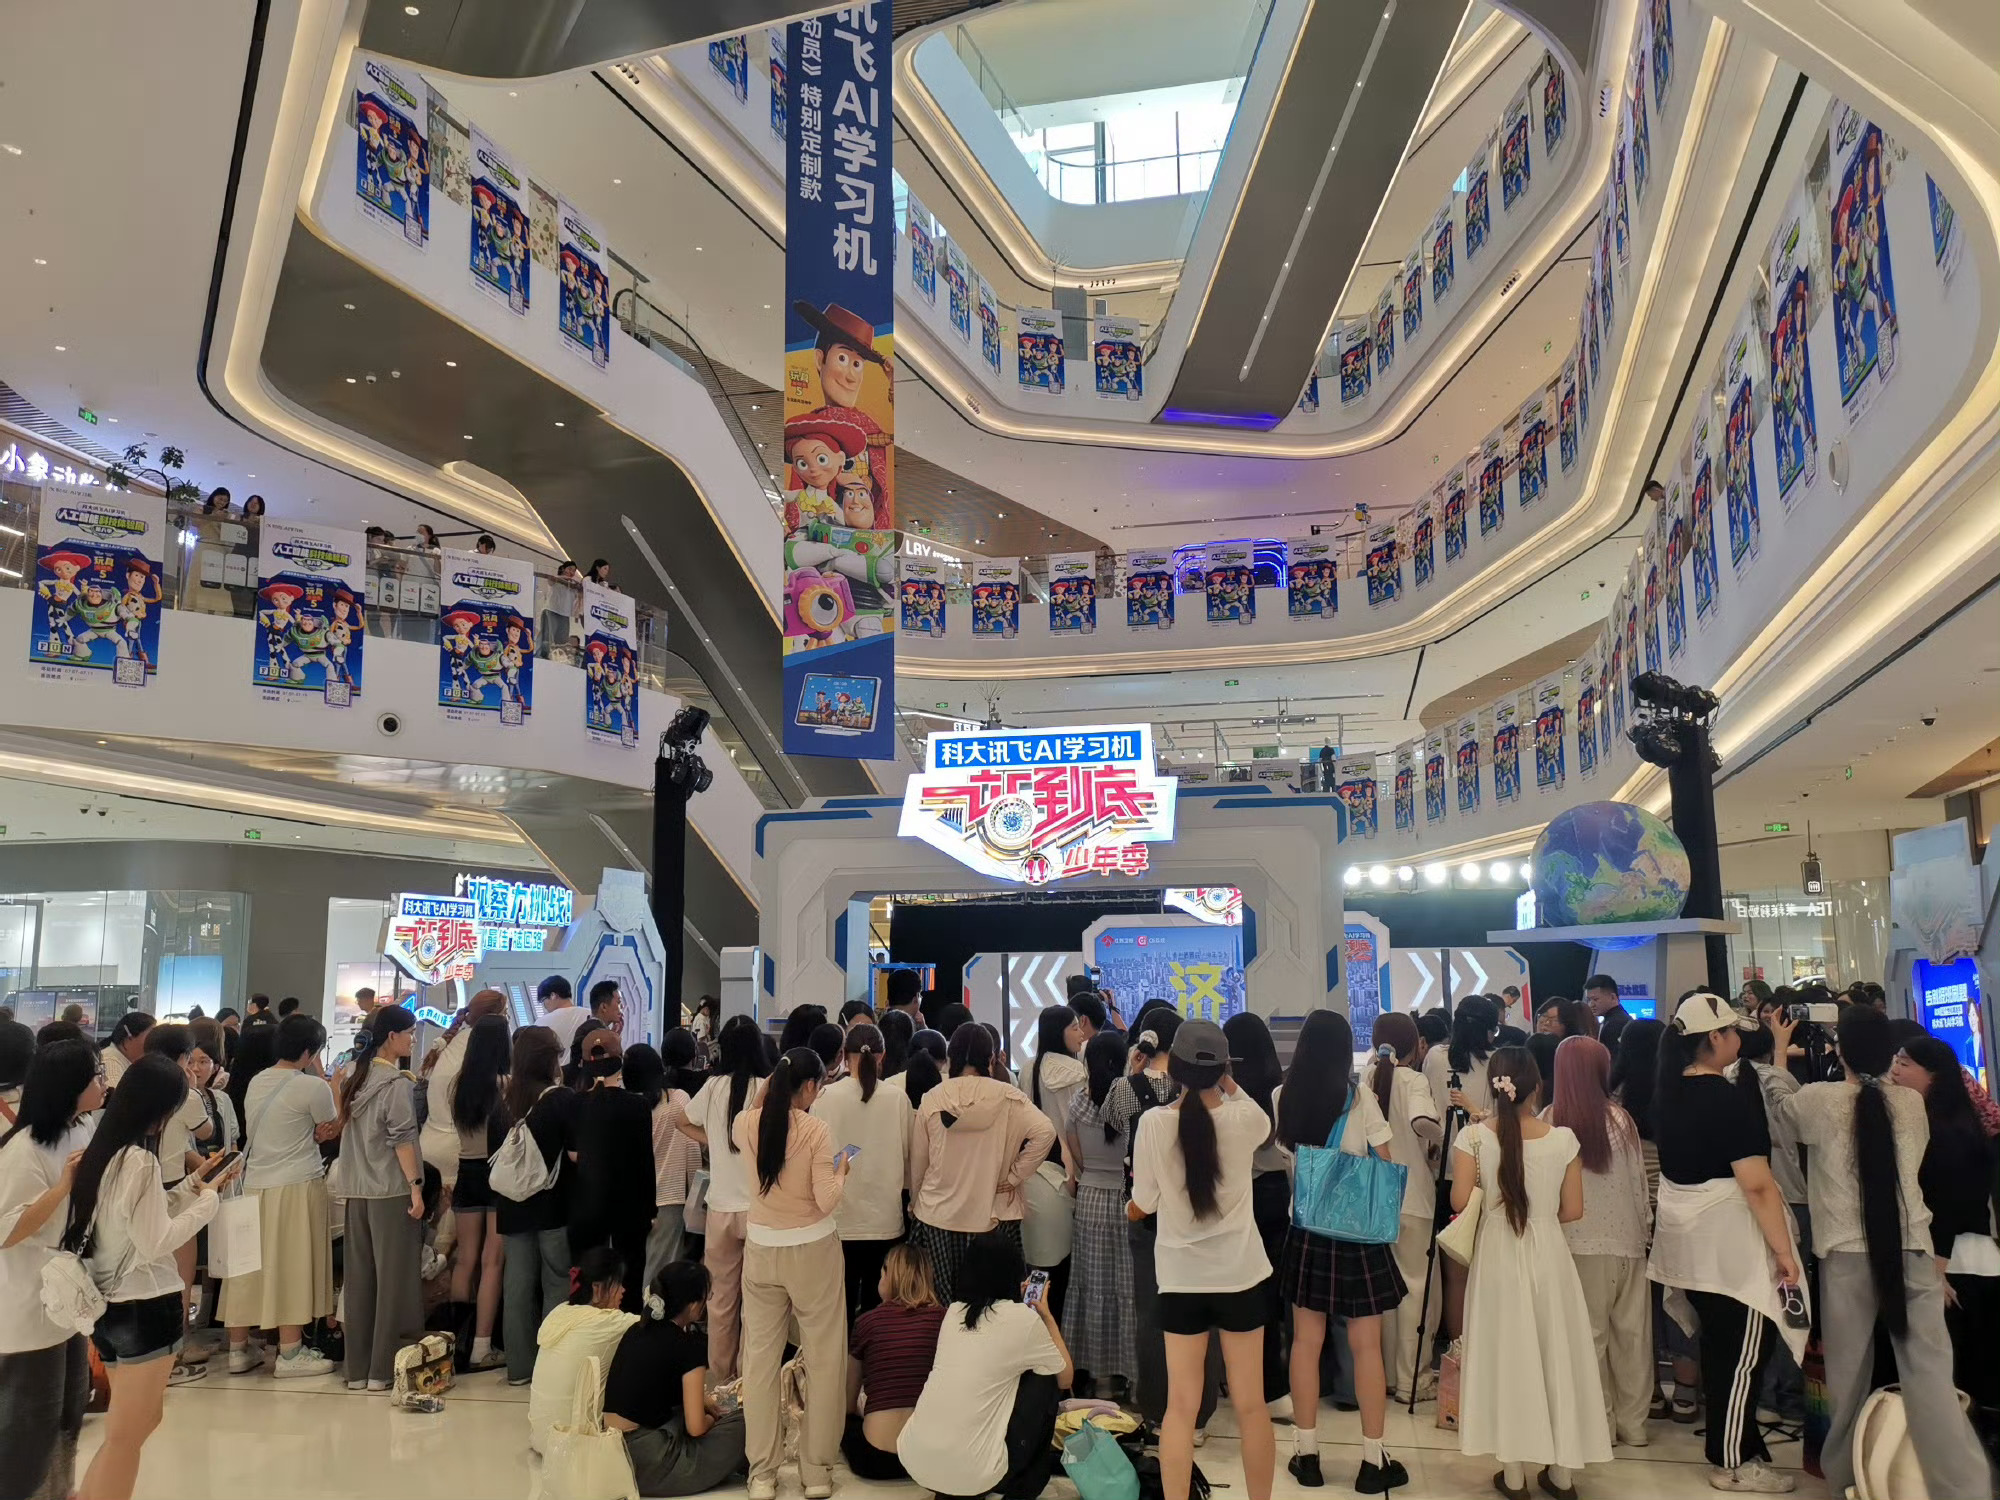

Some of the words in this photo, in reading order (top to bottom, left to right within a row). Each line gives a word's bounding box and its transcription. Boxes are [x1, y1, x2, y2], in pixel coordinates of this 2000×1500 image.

[40, 643, 72, 654] FUN
[942, 735, 1135, 766] 科大讯飞AI学习机
[922, 765, 1155, 849] 一站到底
[1062, 842, 1150, 877] 少年季
[404, 900, 474, 918] 科大讯飞AI学习机
